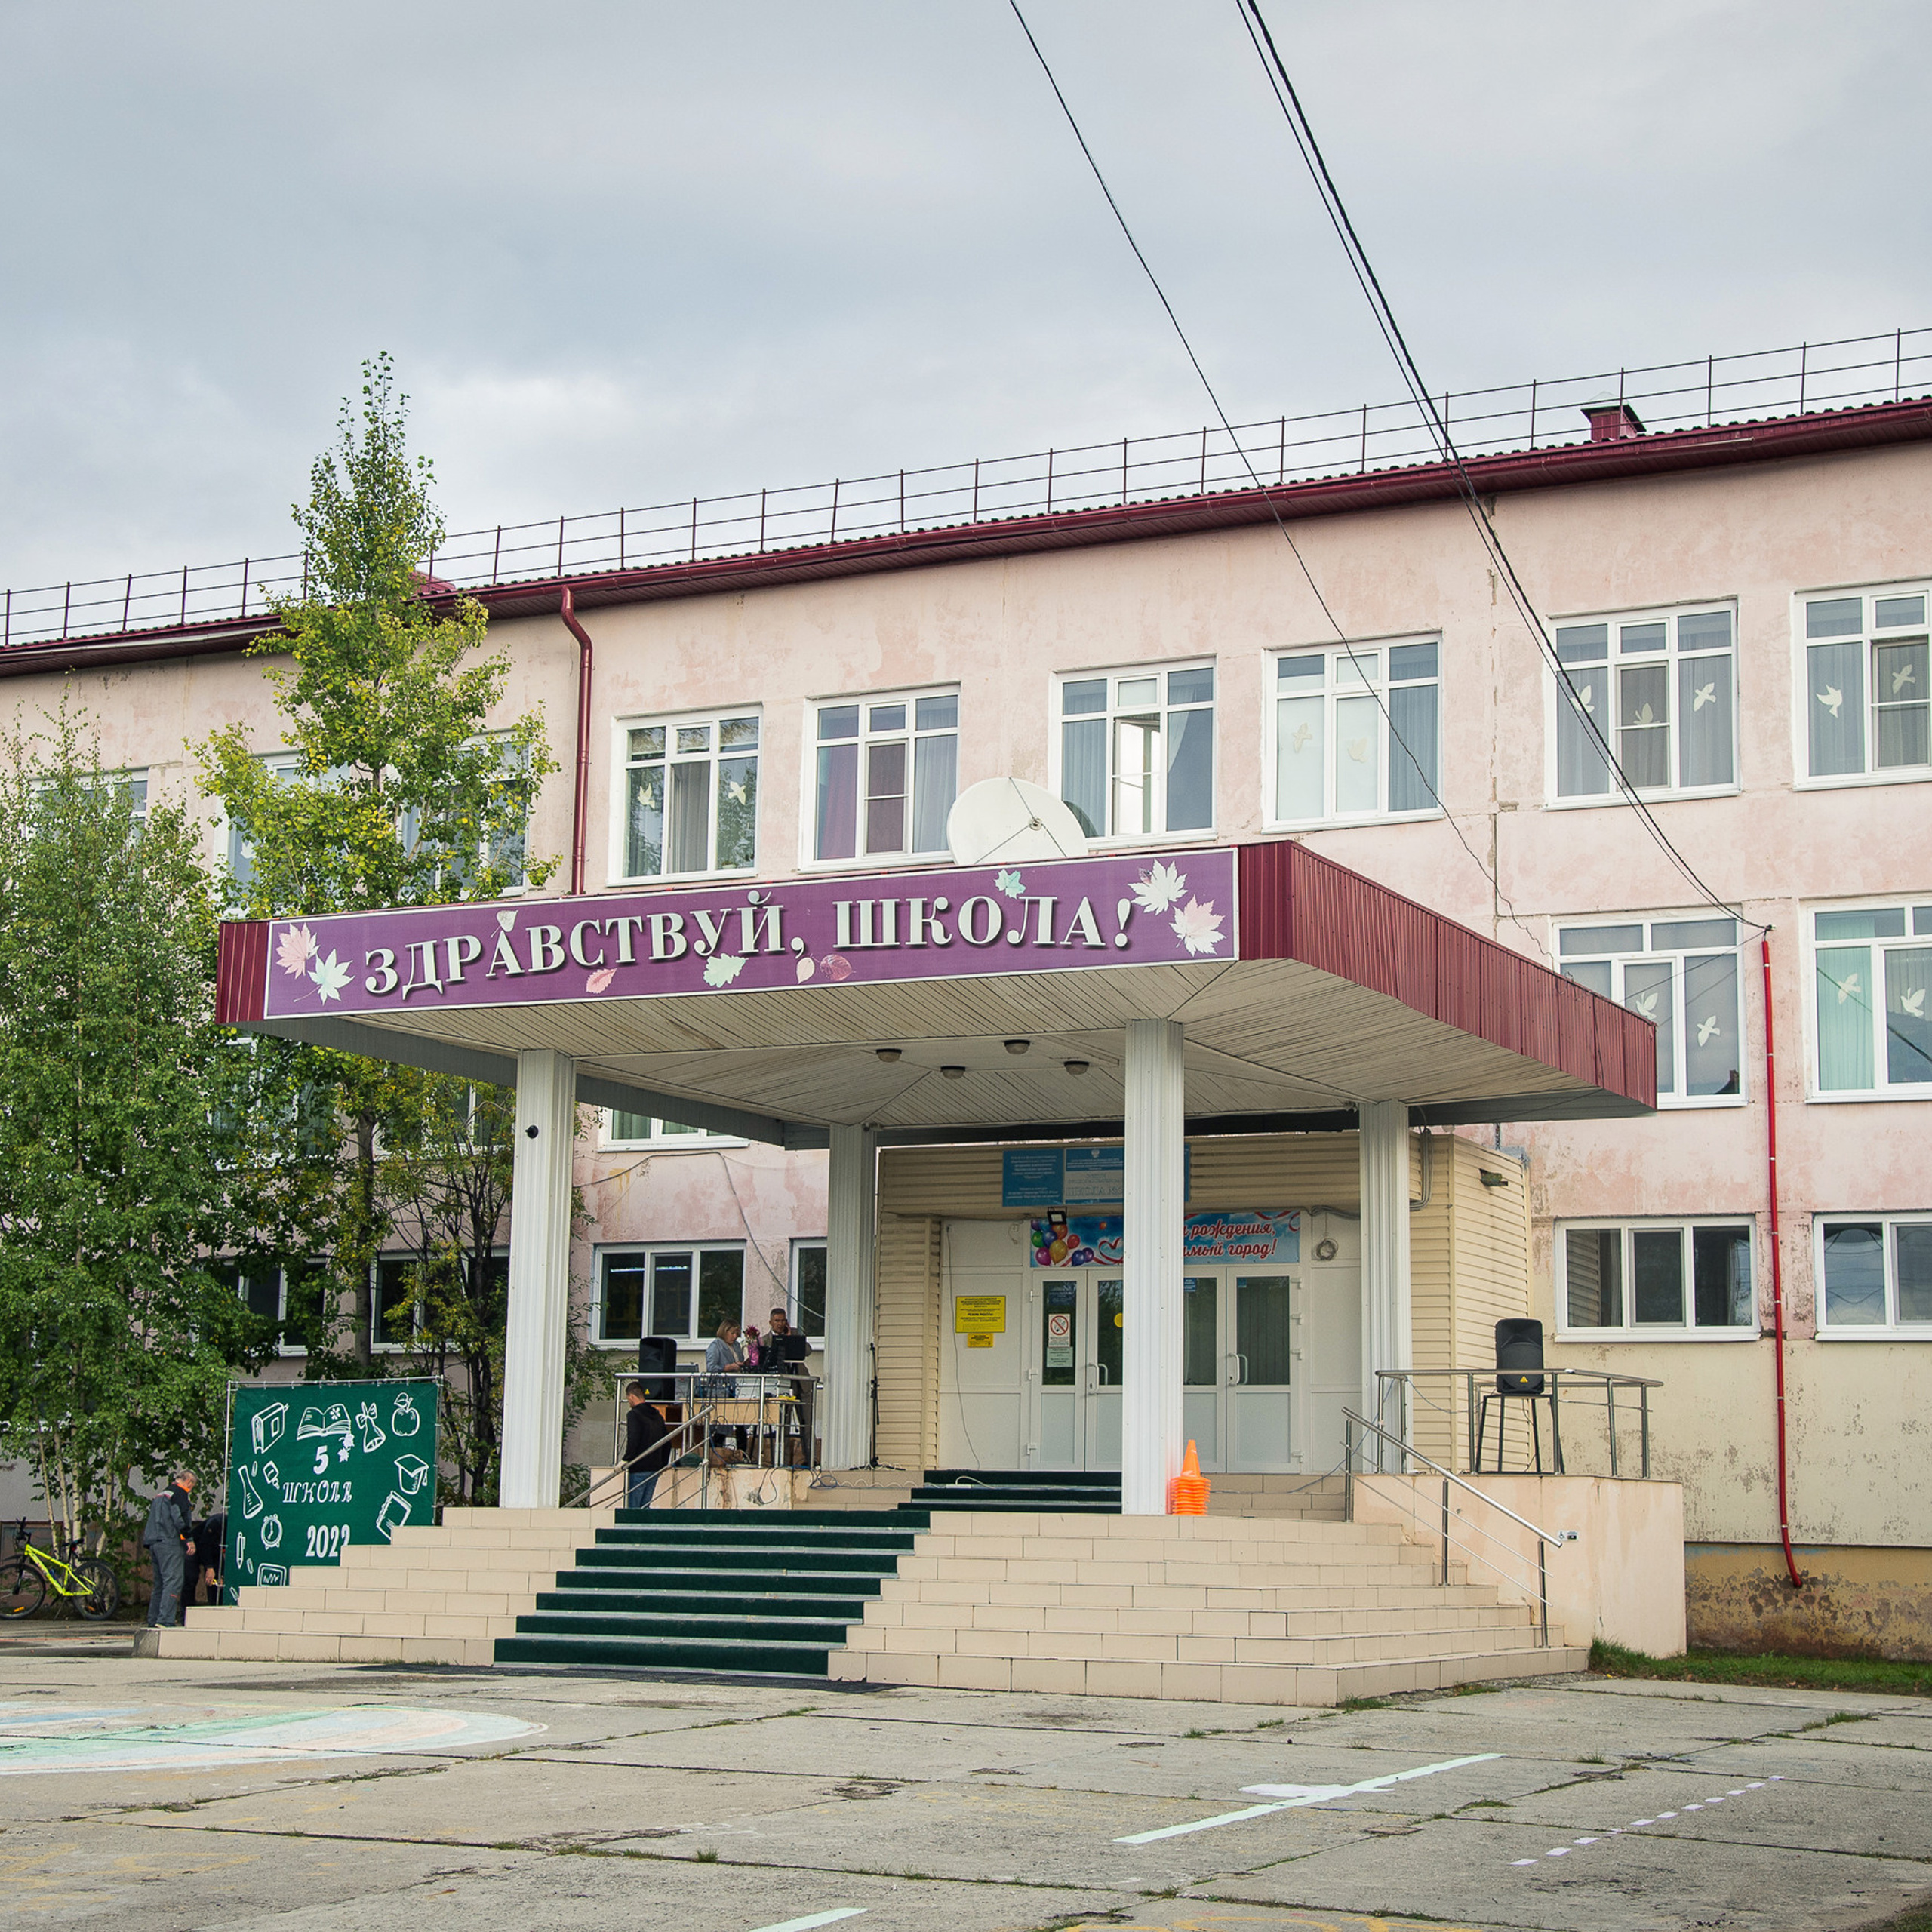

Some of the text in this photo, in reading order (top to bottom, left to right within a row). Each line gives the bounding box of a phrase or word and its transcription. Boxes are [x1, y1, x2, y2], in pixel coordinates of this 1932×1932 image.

[364, 890, 1132, 1001] ЗДРАВСТВУЙ, ШКОЛА!
[1189, 1219, 1275, 1240] рождения,
[1227, 1238, 1278, 1259] город!
[313, 1444, 329, 1475] 5
[282, 1480, 352, 1503] ШКОЛА
[305, 1524, 351, 1558] 2022
